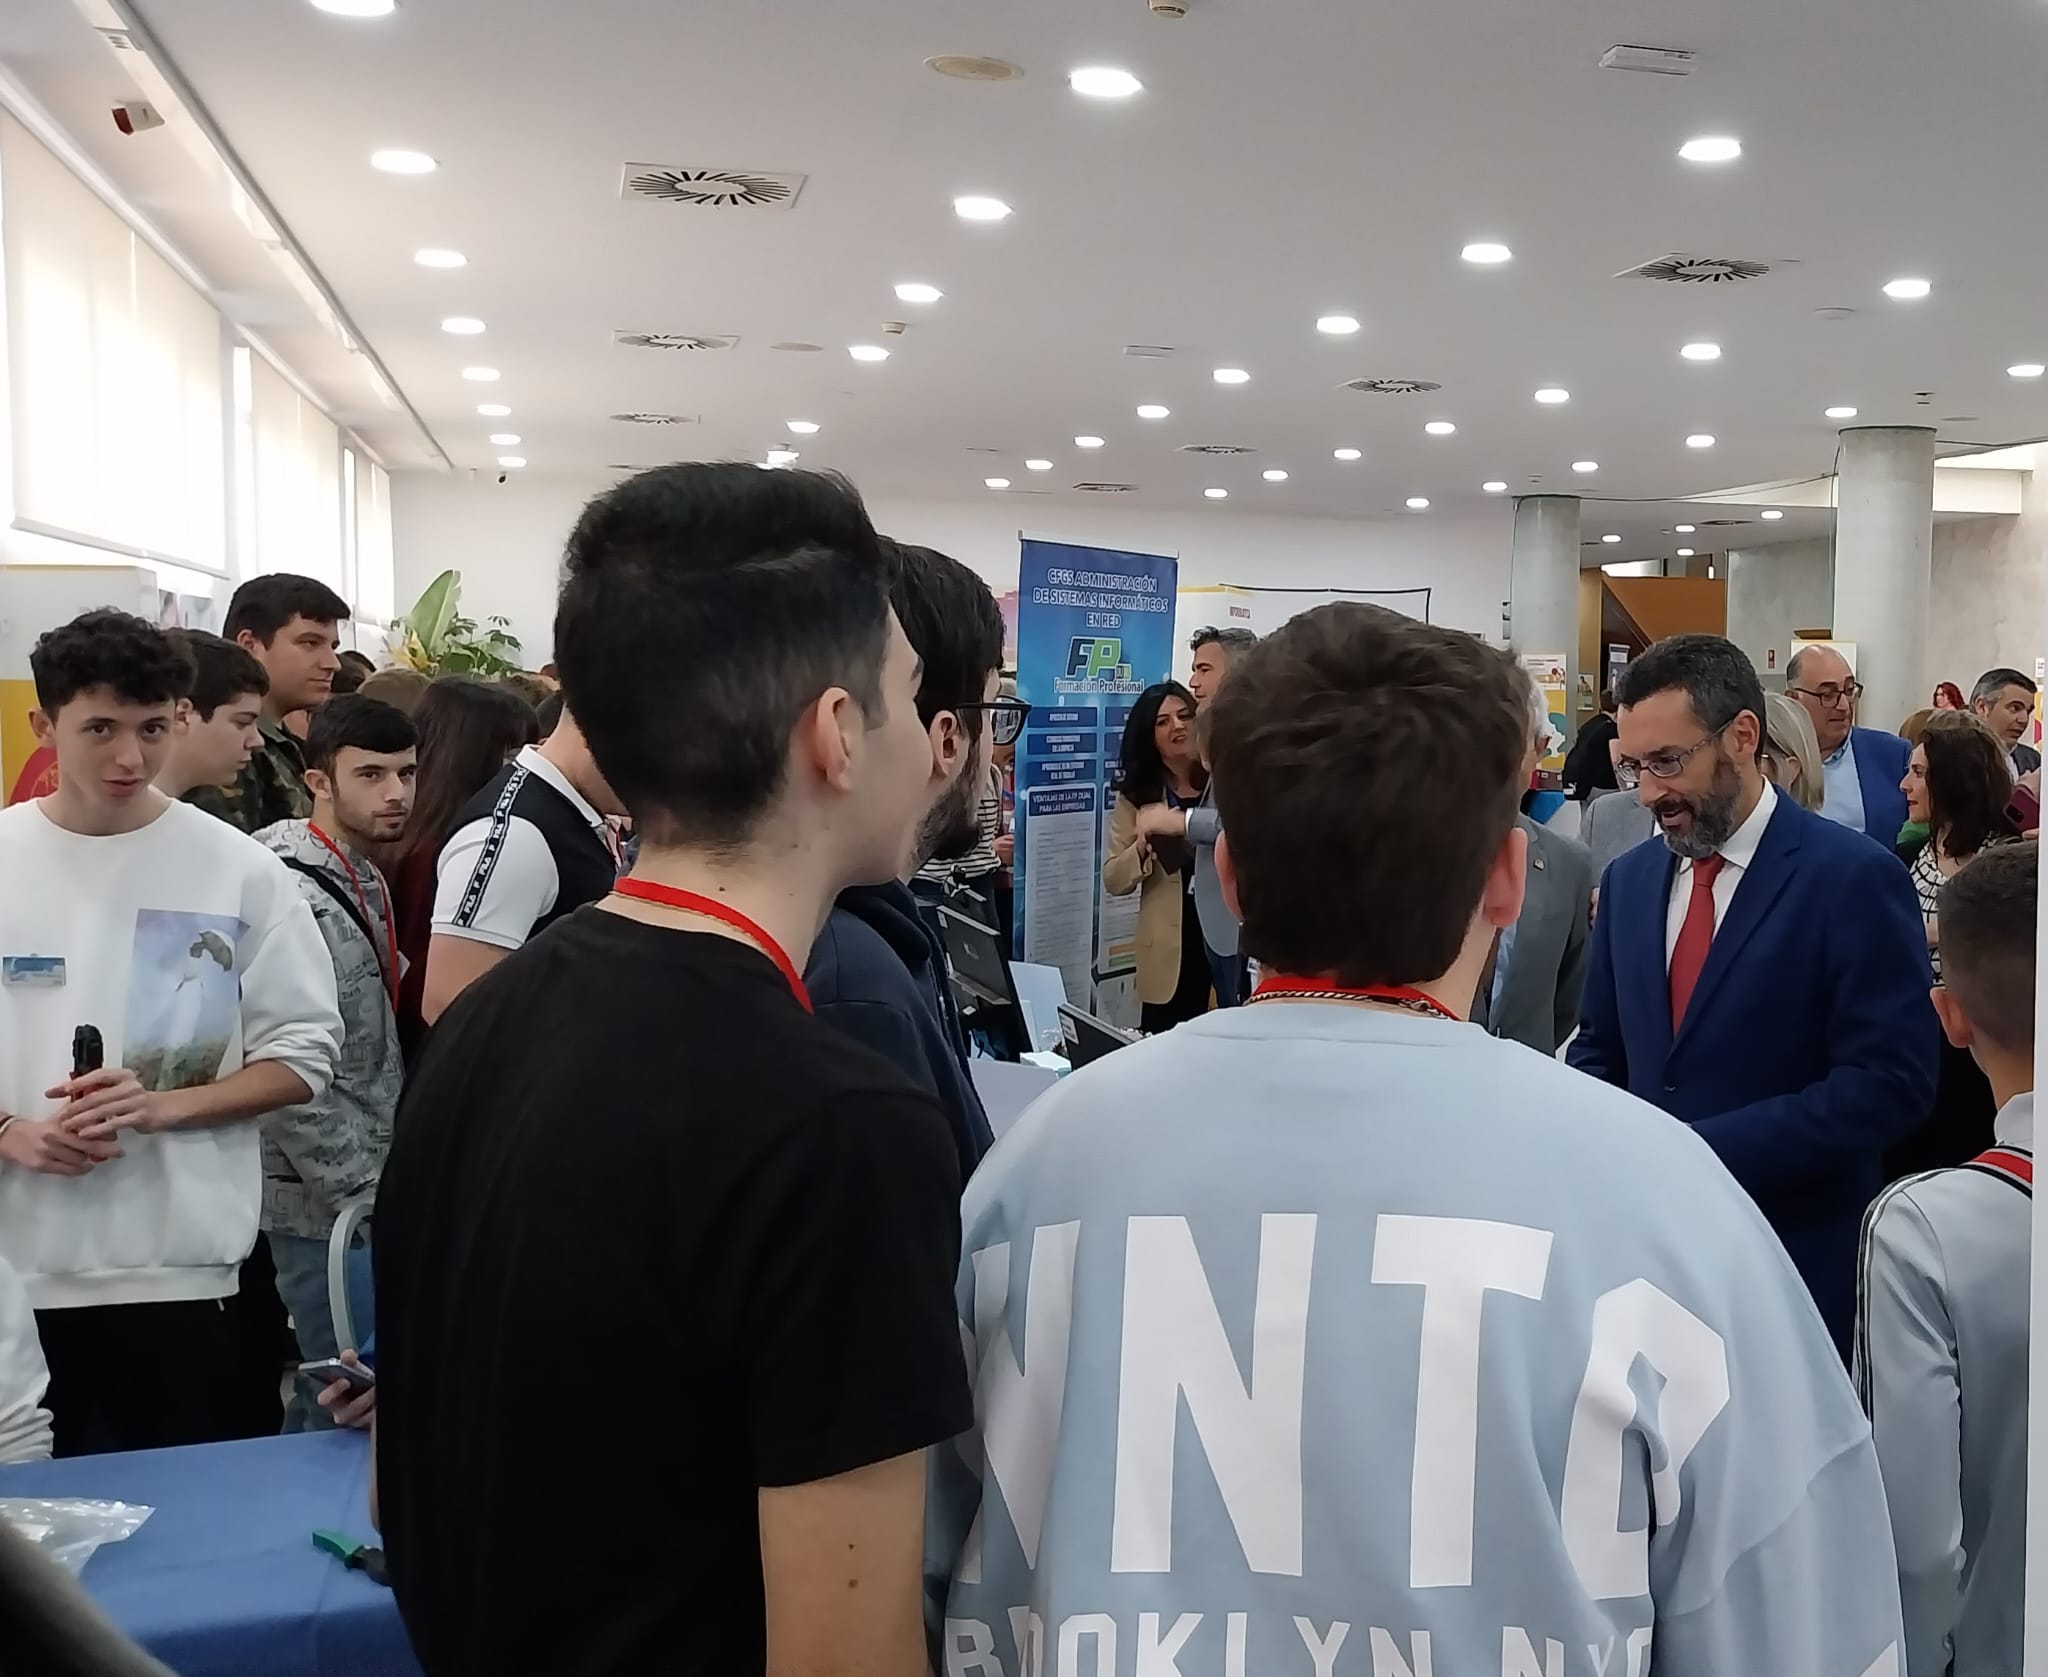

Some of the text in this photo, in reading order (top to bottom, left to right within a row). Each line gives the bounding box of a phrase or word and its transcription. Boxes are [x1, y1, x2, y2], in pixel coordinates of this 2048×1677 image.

[1047, 568, 1158, 593] CFGS ADMINISTRACIÓN
[1033, 588, 1169, 613] DE SISTEMAS INFORMÁTICOS
[1086, 612, 1121, 628] EN RED
[1065, 636, 1122, 679] FP
[1054, 676, 1144, 694] Formación Profesional
[463, 894, 477, 914] FILA
[478, 857, 492, 876] FILA
